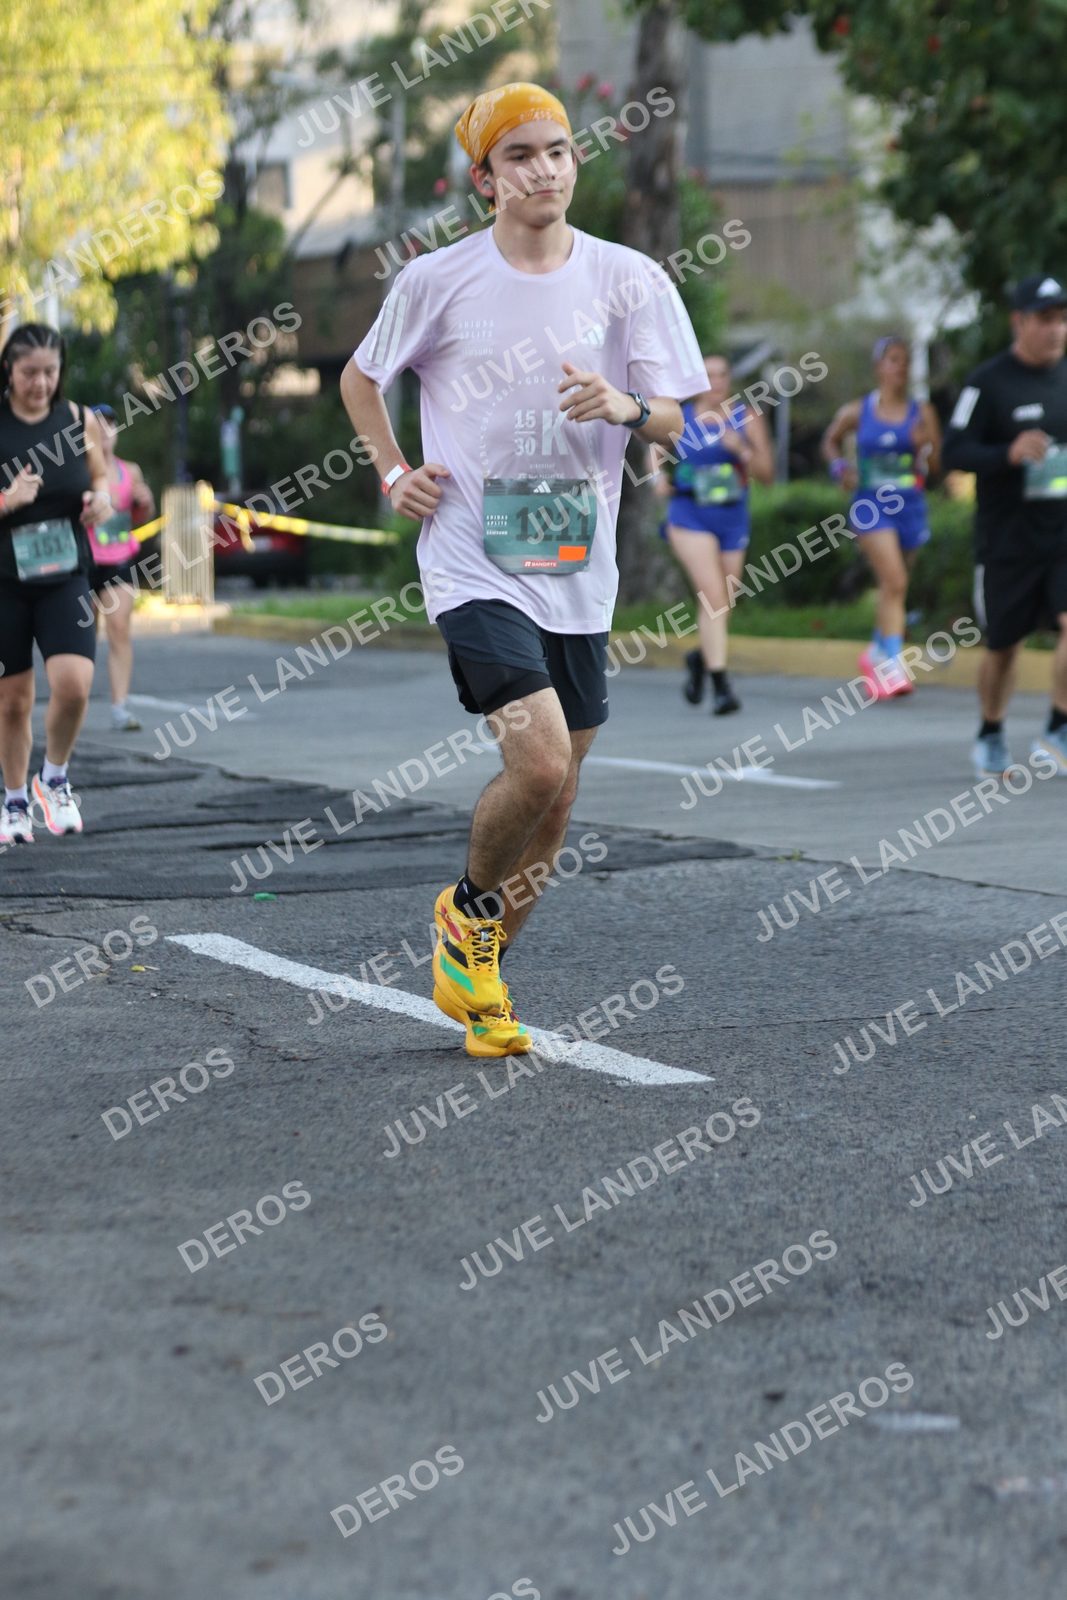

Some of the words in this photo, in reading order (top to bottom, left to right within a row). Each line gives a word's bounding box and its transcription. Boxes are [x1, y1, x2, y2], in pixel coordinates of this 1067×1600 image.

[514, 409, 536, 428] 15
[541, 409, 570, 456] K
[514, 436, 536, 456] 30
[515, 506, 591, 542] 1211
